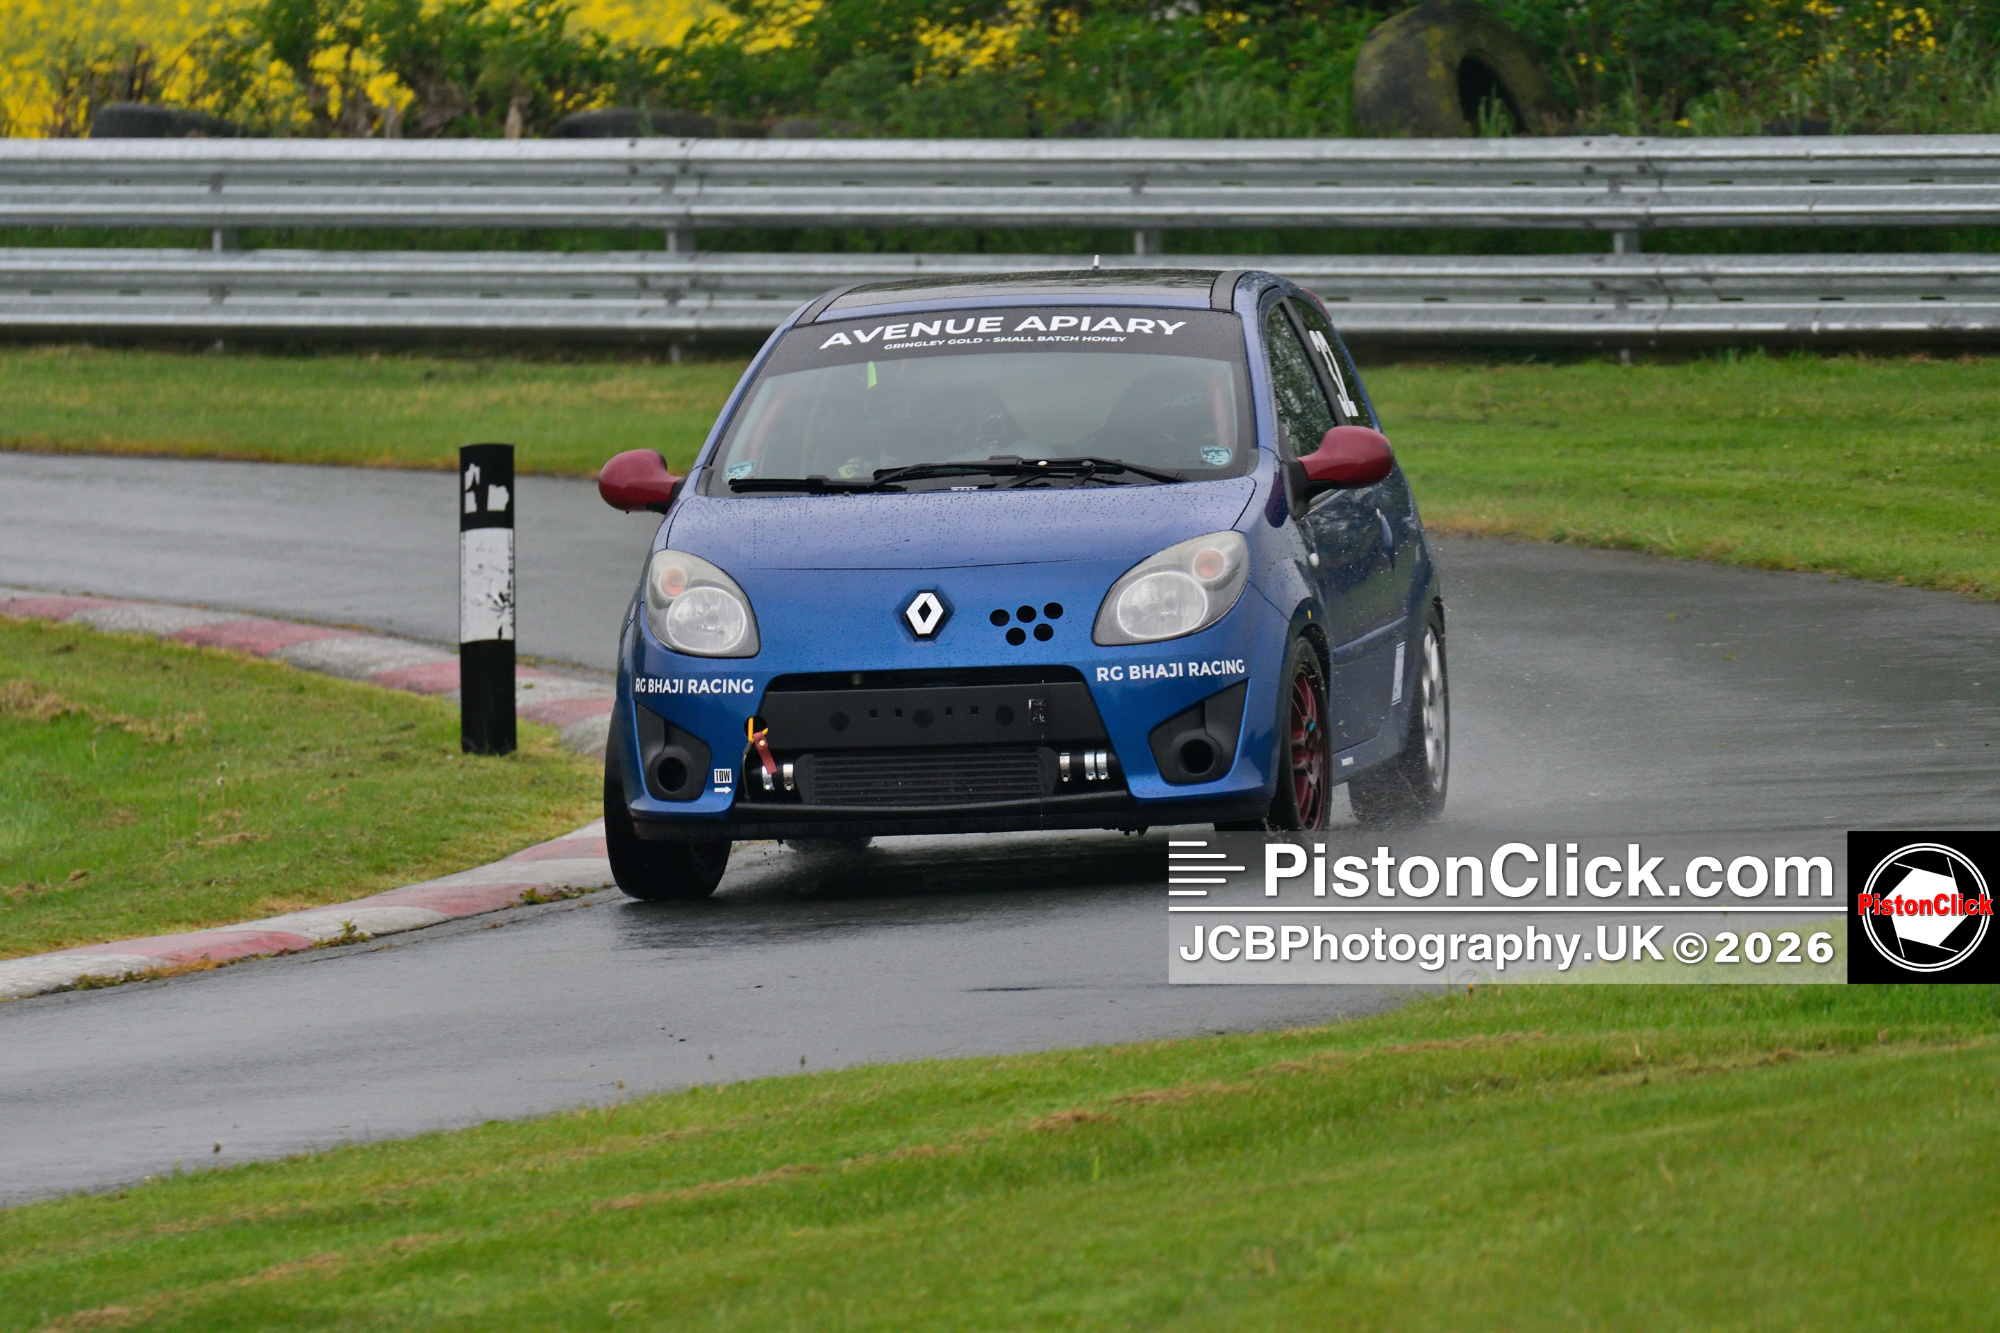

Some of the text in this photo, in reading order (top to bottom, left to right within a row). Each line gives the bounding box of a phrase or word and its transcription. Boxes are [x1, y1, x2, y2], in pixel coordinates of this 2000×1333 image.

[819, 315, 1187, 350] AVENUE APIARY
[883, 340, 945, 350] GRINGLEY
[948, 338, 981, 346] GOLD
[1082, 335, 1127, 343] HONEY
[1096, 659, 1245, 682] RG BHAJI RACING
[635, 677, 754, 694] RG BHAJI RACING
[715, 770, 731, 782] TOW
